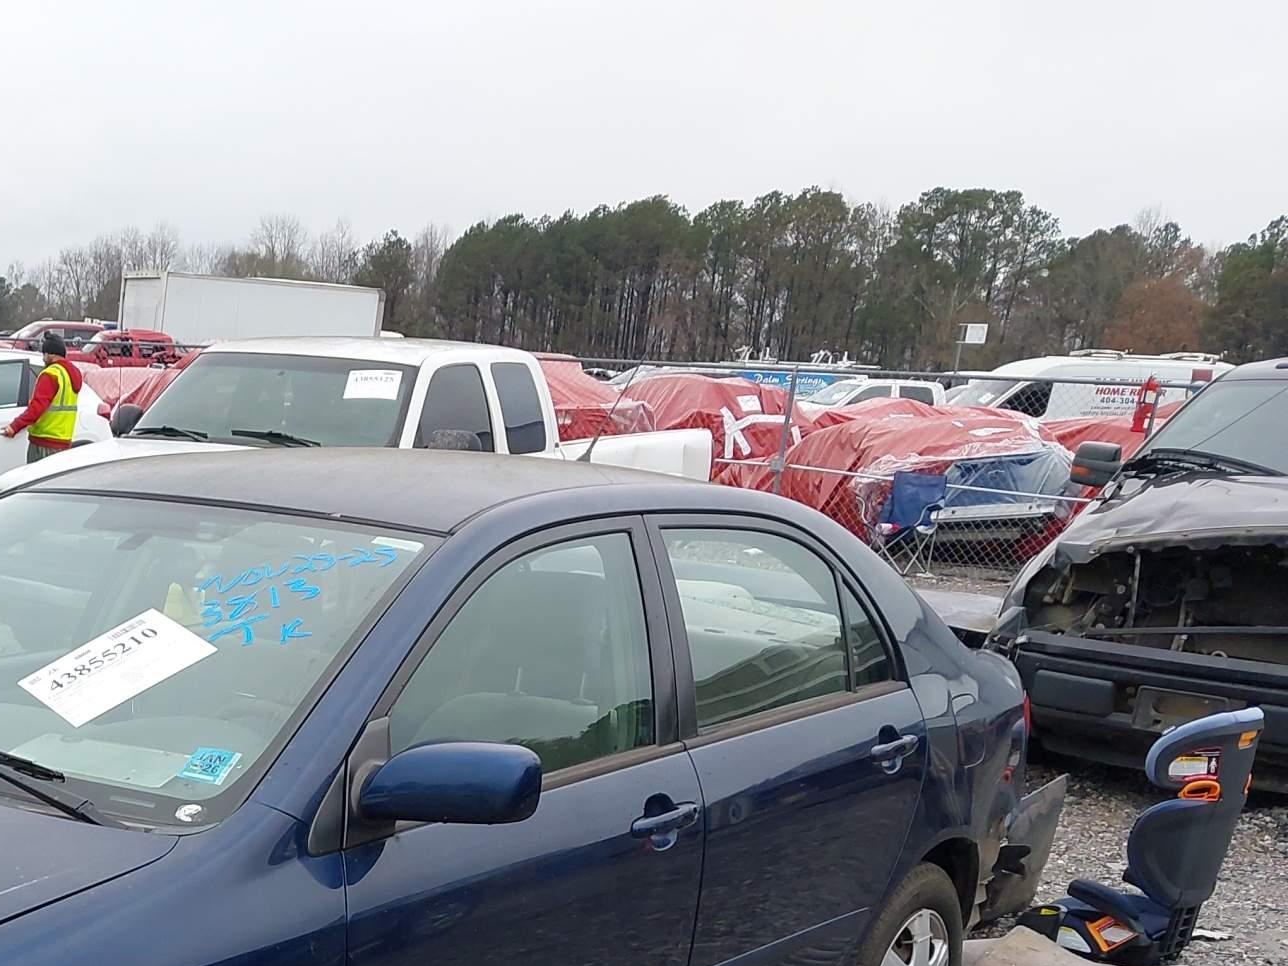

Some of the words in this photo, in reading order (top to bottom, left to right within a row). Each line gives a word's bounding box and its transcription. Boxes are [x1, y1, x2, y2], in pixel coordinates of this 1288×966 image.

[1095, 386, 1128, 396] HOME
[50, 628, 158, 691] 43855210
[197, 752, 226, 765] JAN
